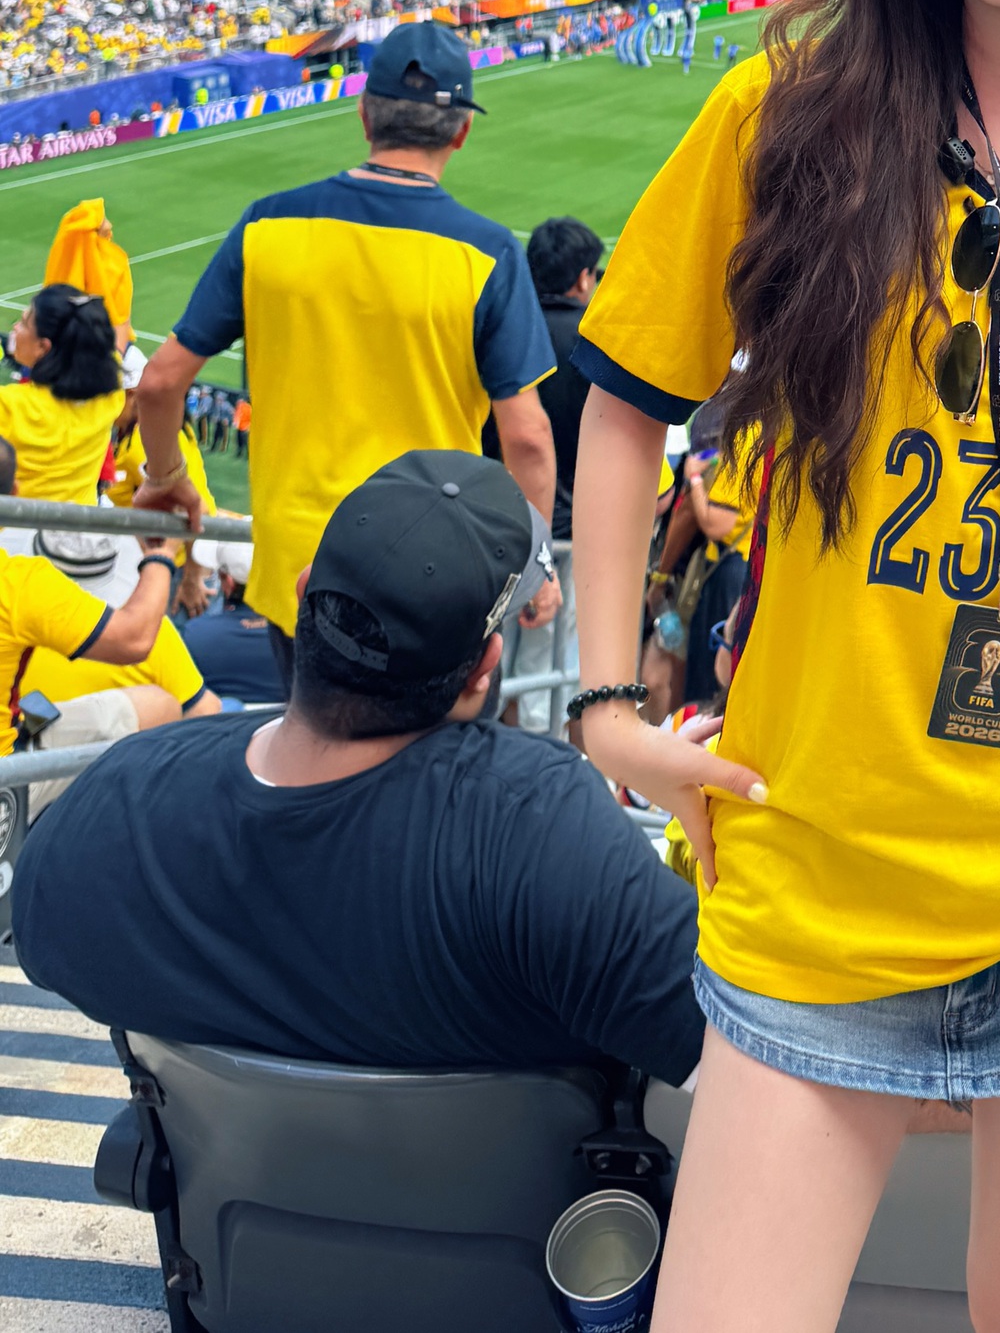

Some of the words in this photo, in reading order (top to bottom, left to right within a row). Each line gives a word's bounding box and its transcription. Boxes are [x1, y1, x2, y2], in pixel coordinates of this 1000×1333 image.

[278, 82, 315, 111] VISA
[194, 101, 237, 128] VISA
[39, 126, 118, 160] AIRWAYS
[968, 695, 995, 709] FIFA
[948, 712, 985, 725] WORLD
